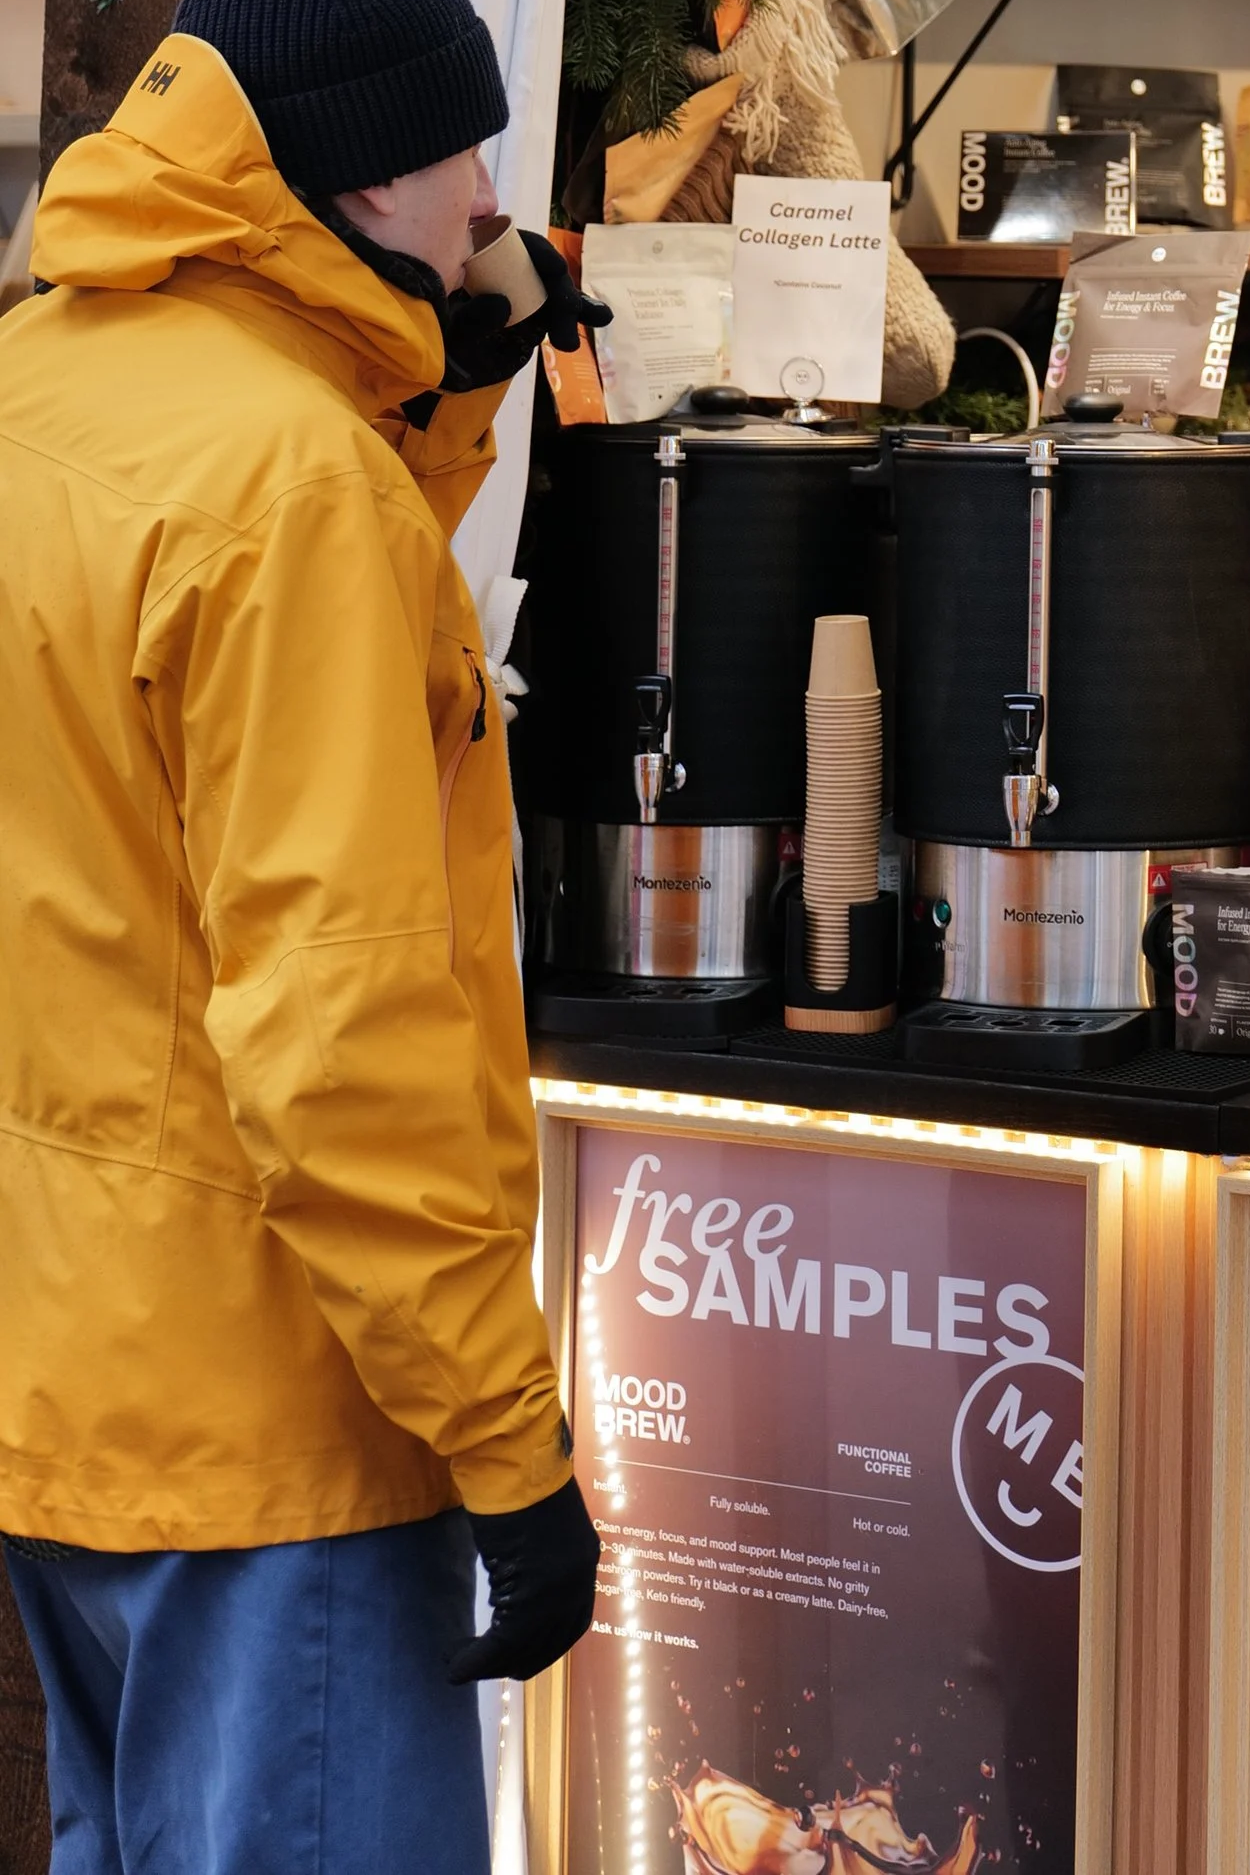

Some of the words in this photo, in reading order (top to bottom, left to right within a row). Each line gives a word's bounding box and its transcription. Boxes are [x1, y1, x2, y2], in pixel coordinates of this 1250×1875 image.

[140, 60, 181, 96] HH
[961, 132, 987, 211] MOOD
[770, 202, 853, 221] Caramel
[739, 228, 823, 250] Collagen
[830, 233, 881, 250] Latte
[1046, 290, 1080, 389] MOOD
[1200, 288, 1241, 390] BREW.
[1217, 920, 1227, 931] for
[1218, 906, 1244, 919] Infused
[1172, 904, 1198, 1017] MOOD
[584, 1153, 793, 1275] free
[636, 1241, 1050, 1361] SAMPLES
[594, 1374, 687, 1411] MOOD
[838, 1443, 912, 1465] FUNCTIONAL
[865, 1461, 912, 1478] COFFEE
[710, 1495, 732, 1513] Fully
[734, 1498, 771, 1516] soluble.
[853, 1517, 871, 1532] Hot
[874, 1523, 884, 1533] or
[886, 1524, 911, 1537] cold.
[593, 1519, 621, 1535] Clean
[623, 1524, 657, 1542] energy,
[659, 1529, 687, 1546] focus,
[689, 1534, 708, 1549] and
[709, 1537, 737, 1553] mood
[738, 1543, 778, 1560] support.
[780, 1547, 805, 1563] Most
[807, 1552, 840, 1570] people
[842, 1556, 861, 1572] feel
[668, 1551, 695, 1566] Made
[697, 1555, 717, 1570] with
[719, 1560, 783, 1580] water-soluble
[785, 1570, 825, 1588] extracts.
[828, 1576, 843, 1590] No
[845, 1579, 870, 1597] gritty
[643, 1568, 687, 1587] powders.
[689, 1575, 703, 1591] Try
[713, 1579, 738, 1594] black
[752, 1588, 764, 1598] as
[775, 1591, 809, 1608] creamy
[811, 1593, 836, 1610] latte.
[838, 1598, 889, 1620] Dairy-free,
[646, 1589, 669, 1603] Keto
[670, 1592, 706, 1611] friendly.
[592, 1620, 613, 1636] Ask
[664, 1633, 699, 1649] works.
